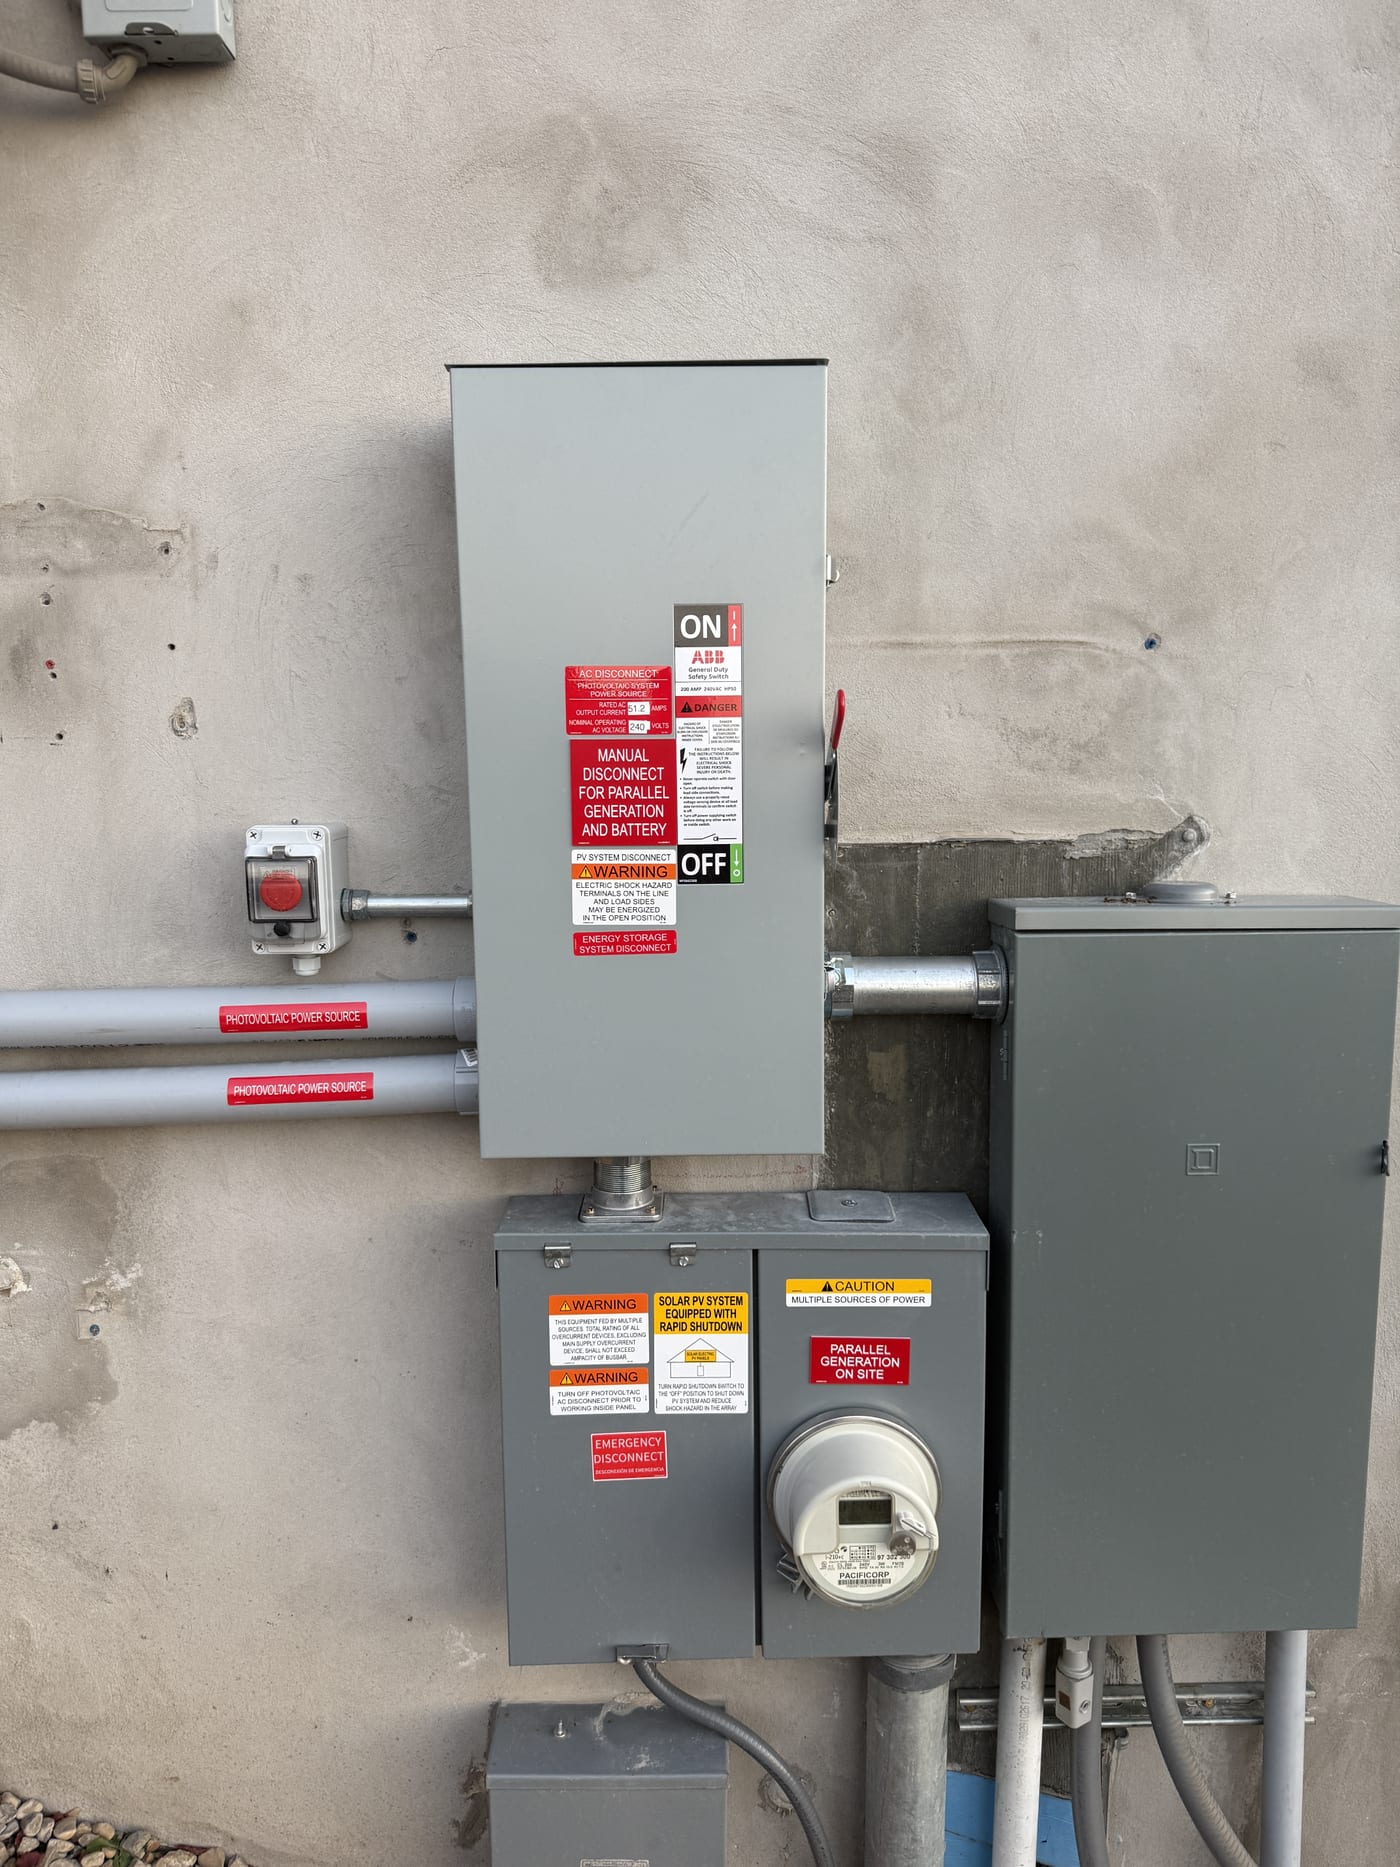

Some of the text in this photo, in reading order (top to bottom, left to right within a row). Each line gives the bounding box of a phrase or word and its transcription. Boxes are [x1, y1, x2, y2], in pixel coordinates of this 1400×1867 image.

[681, 615, 721, 639] ON
[692, 650, 724, 664] ABB
[579, 670, 656, 678] AC DISCONNECT
[598, 749, 649, 762] MANUAL
[583, 767, 664, 780] DISCONNECT
[579, 786, 605, 799] FOR
[608, 786, 669, 799] PARALLEL
[584, 805, 664, 818] GENERATION
[582, 823, 667, 836] AND BATTERY
[682, 853, 726, 875] OFF
[594, 866, 668, 878] WARNING
[582, 934, 667, 943] ENERGY STORAGE
[580, 944, 671, 954] SYSTEM DISCONNECT
[226, 1011, 360, 1024] PHOTOVOLTAIC POWER SOURCE
[234, 1081, 366, 1096] PHOTOVOLTAIC POWER SOURCE
[836, 1281, 894, 1291] CAUTION
[573, 1299, 636, 1310] WARNING
[659, 1296, 743, 1305] SOLAR PV SYSTEM
[666, 1309, 736, 1318] EQUIPPED WITH
[660, 1322, 742, 1331] RAPID SHUTDOWN
[830, 1344, 890, 1355] PARALLEL
[821, 1357, 899, 1367] GENERATION
[575, 1372, 638, 1383] WARNING
[836, 1369, 884, 1379] ON SITE
[596, 1437, 661, 1448] EMERGENCY
[594, 1452, 664, 1463] DISCONNECT
